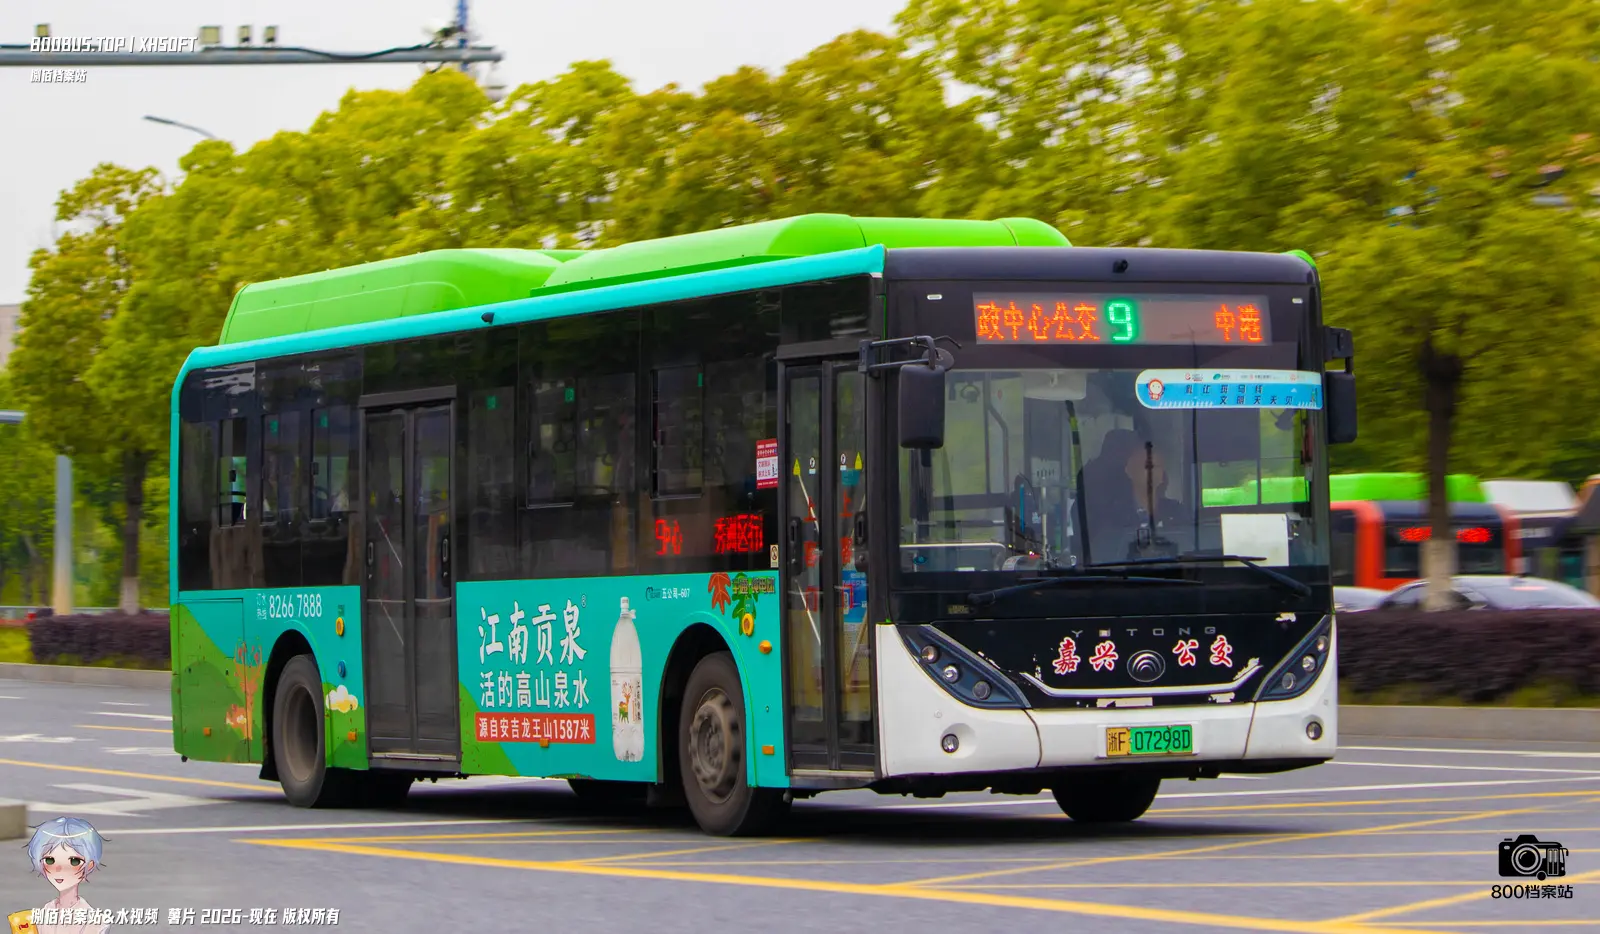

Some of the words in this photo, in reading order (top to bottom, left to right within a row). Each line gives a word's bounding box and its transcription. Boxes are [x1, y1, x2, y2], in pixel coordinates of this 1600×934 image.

[976, 301, 1100, 340] 政中心公交
[1107, 302, 1133, 342] 9
[269, 595, 294, 618] 8266
[296, 593, 323, 617] 7888
[478, 599, 587, 666] 江南贡泉
[1053, 637, 1119, 675] 嘉兴
[1172, 634, 1233, 667] 公交
[480, 670, 590, 708] 活的高山泉水
[479, 717, 590, 740] 源自安吉龙王山1587米
